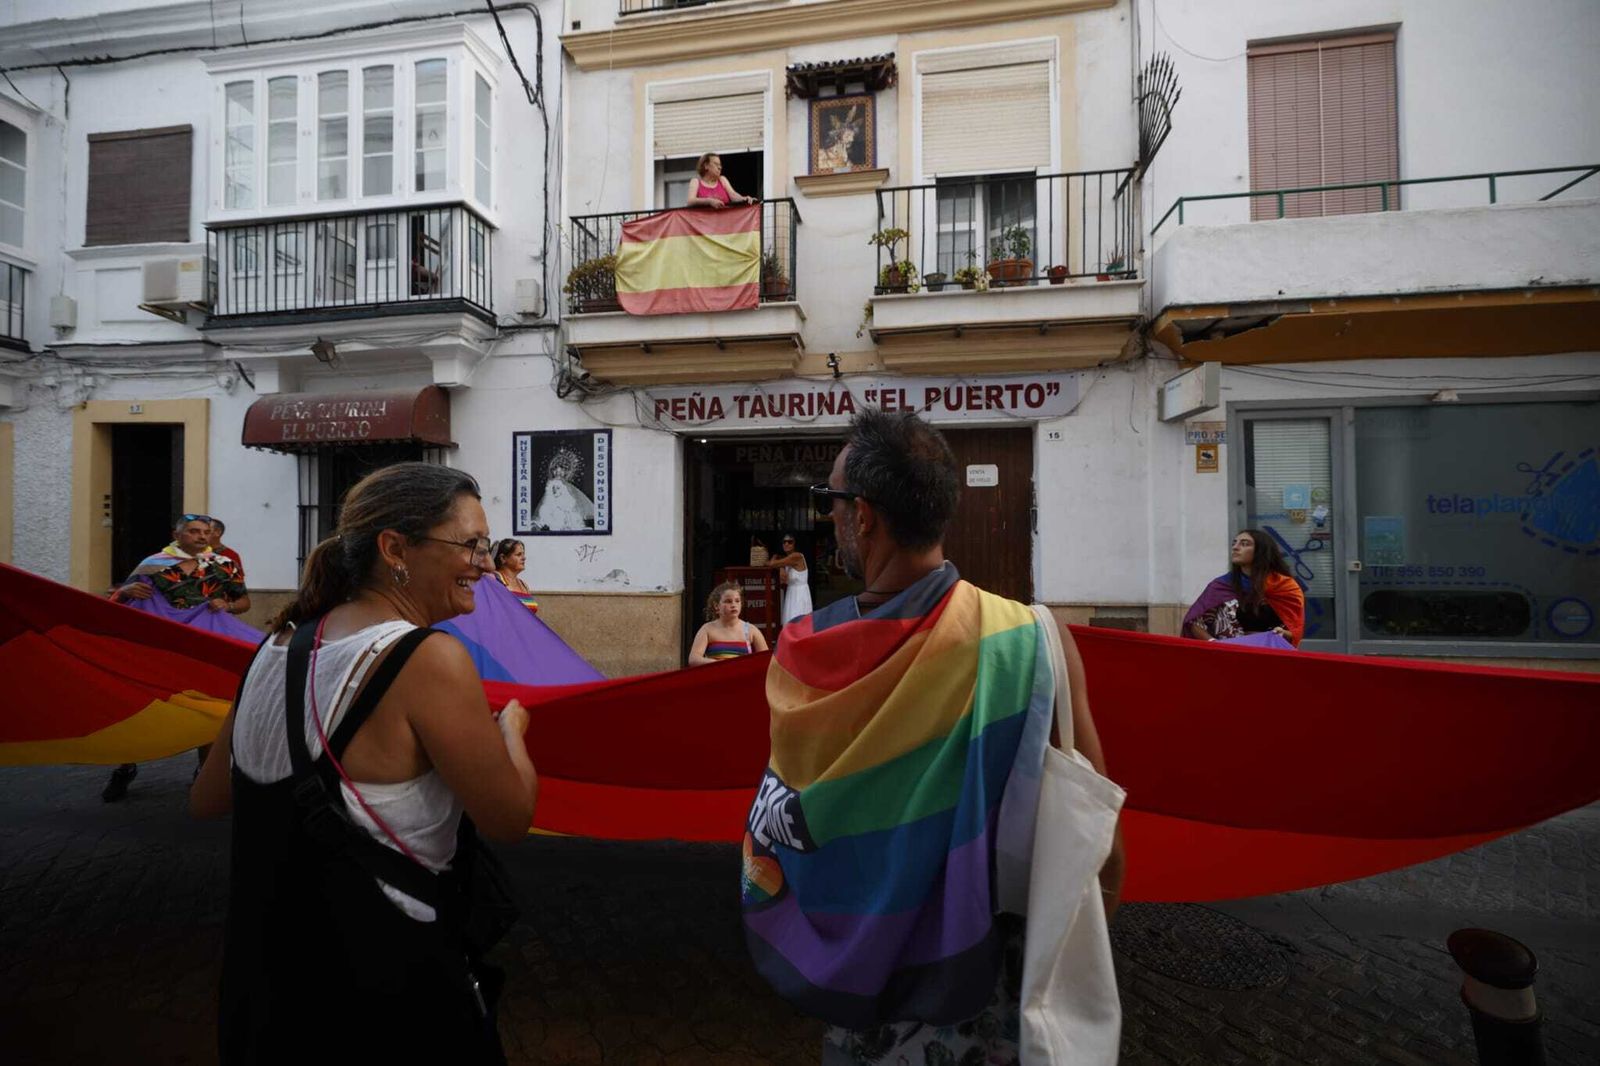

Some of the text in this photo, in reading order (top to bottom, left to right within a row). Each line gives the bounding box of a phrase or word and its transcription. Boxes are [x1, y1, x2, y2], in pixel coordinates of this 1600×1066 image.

[654, 391, 725, 421] PEÑA
[733, 391, 856, 418] TAURINA
[282, 420, 371, 440] EL PUERTO
[735, 443, 839, 463] PEÑA TAUR
[520, 441, 528, 527] NUESTRA SRA DEL
[597, 437, 605, 527] DESCONSUELO
[1458, 566, 1485, 577] 390
